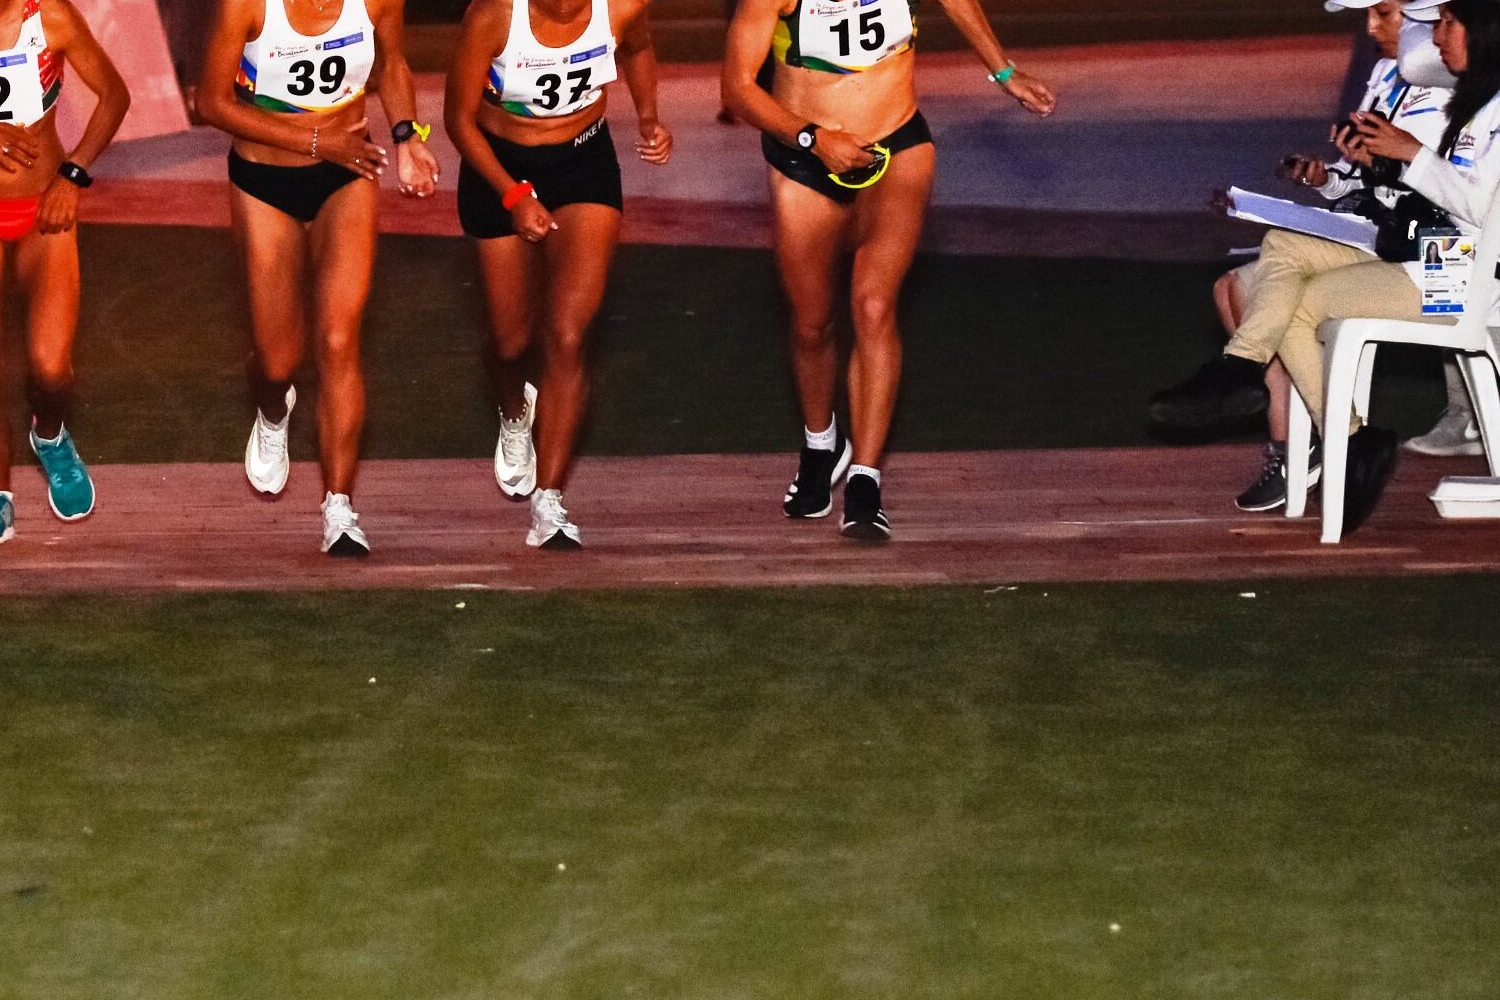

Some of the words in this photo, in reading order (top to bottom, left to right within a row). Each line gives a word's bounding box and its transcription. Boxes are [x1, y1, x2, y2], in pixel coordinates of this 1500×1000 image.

[829, 8, 886, 57] 15
[286, 55, 347, 97] 39
[532, 67, 592, 110] 37
[574, 123, 597, 147] NIKE
